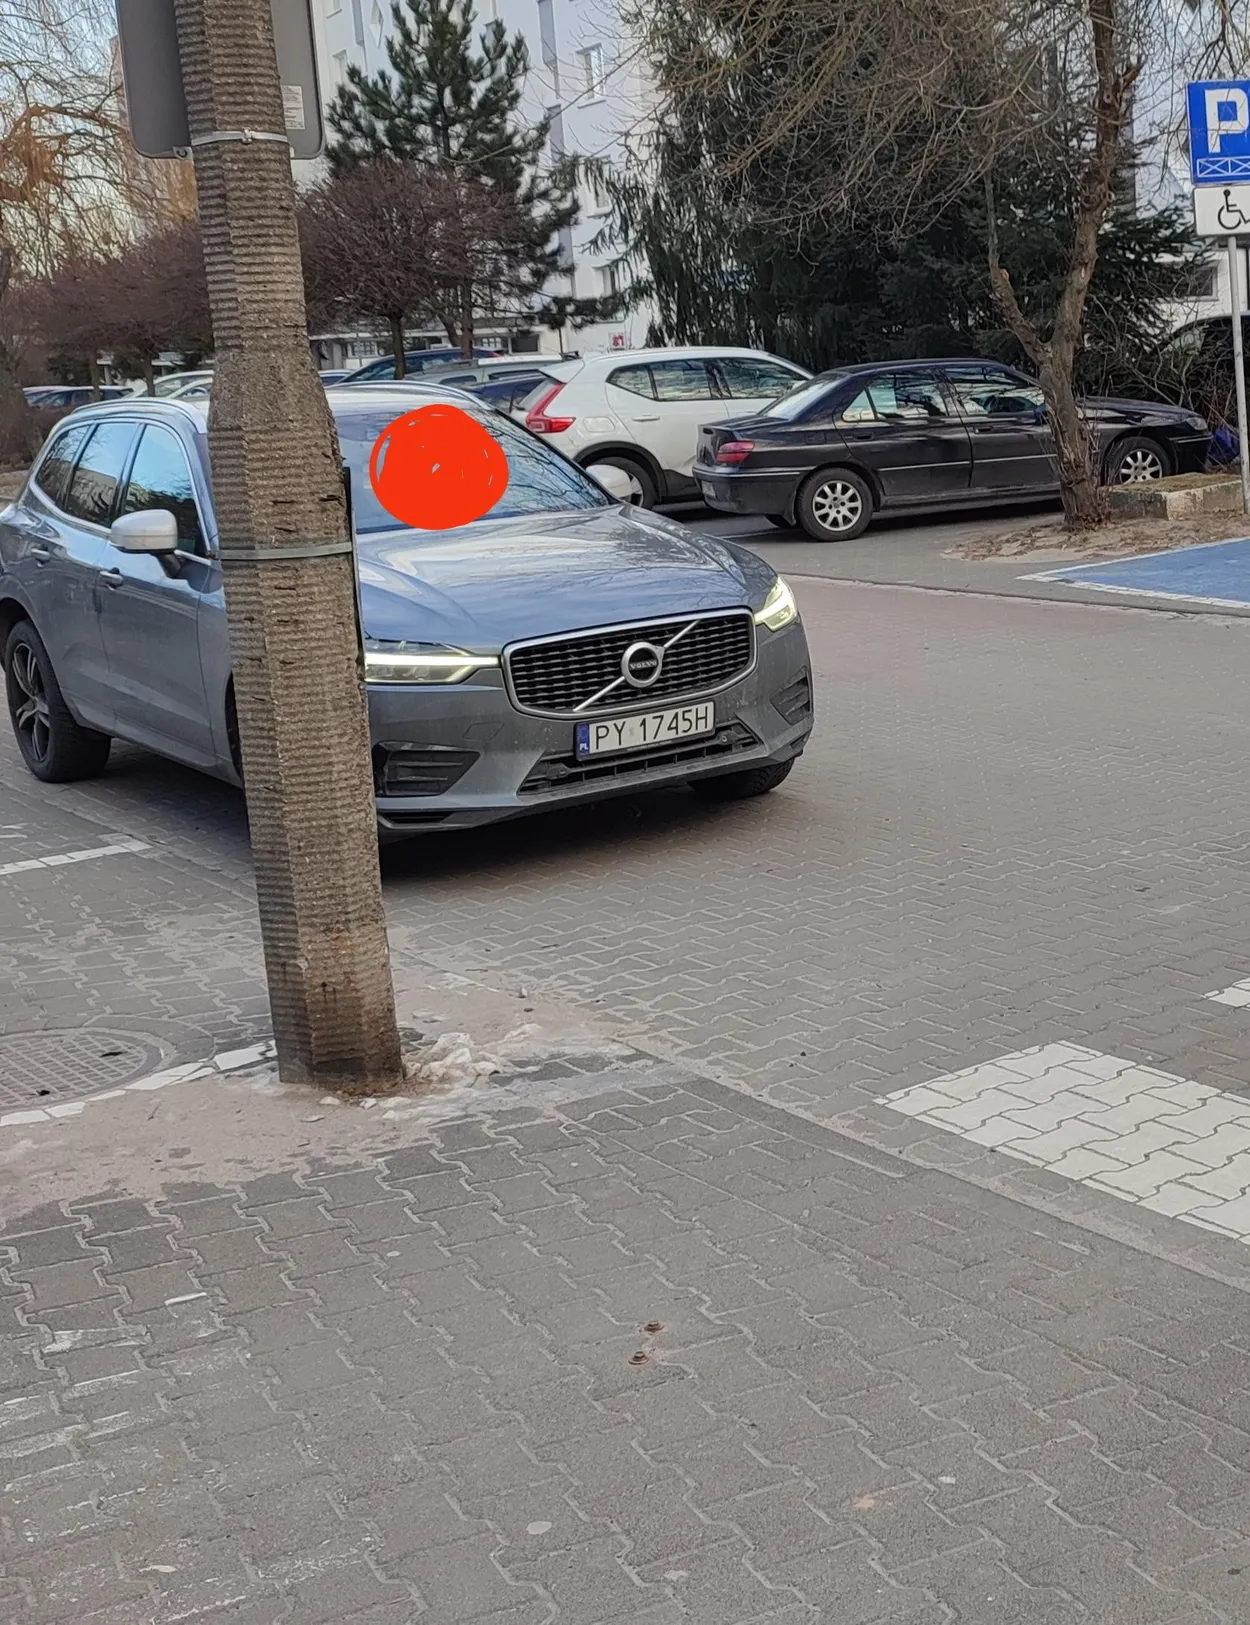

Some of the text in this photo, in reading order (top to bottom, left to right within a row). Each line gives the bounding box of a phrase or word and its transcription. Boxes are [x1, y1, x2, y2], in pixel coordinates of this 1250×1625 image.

[1204, 88, 1250, 153] P
[630, 660, 657, 669] VOLVO
[595, 705, 708, 749] PY 1745H
